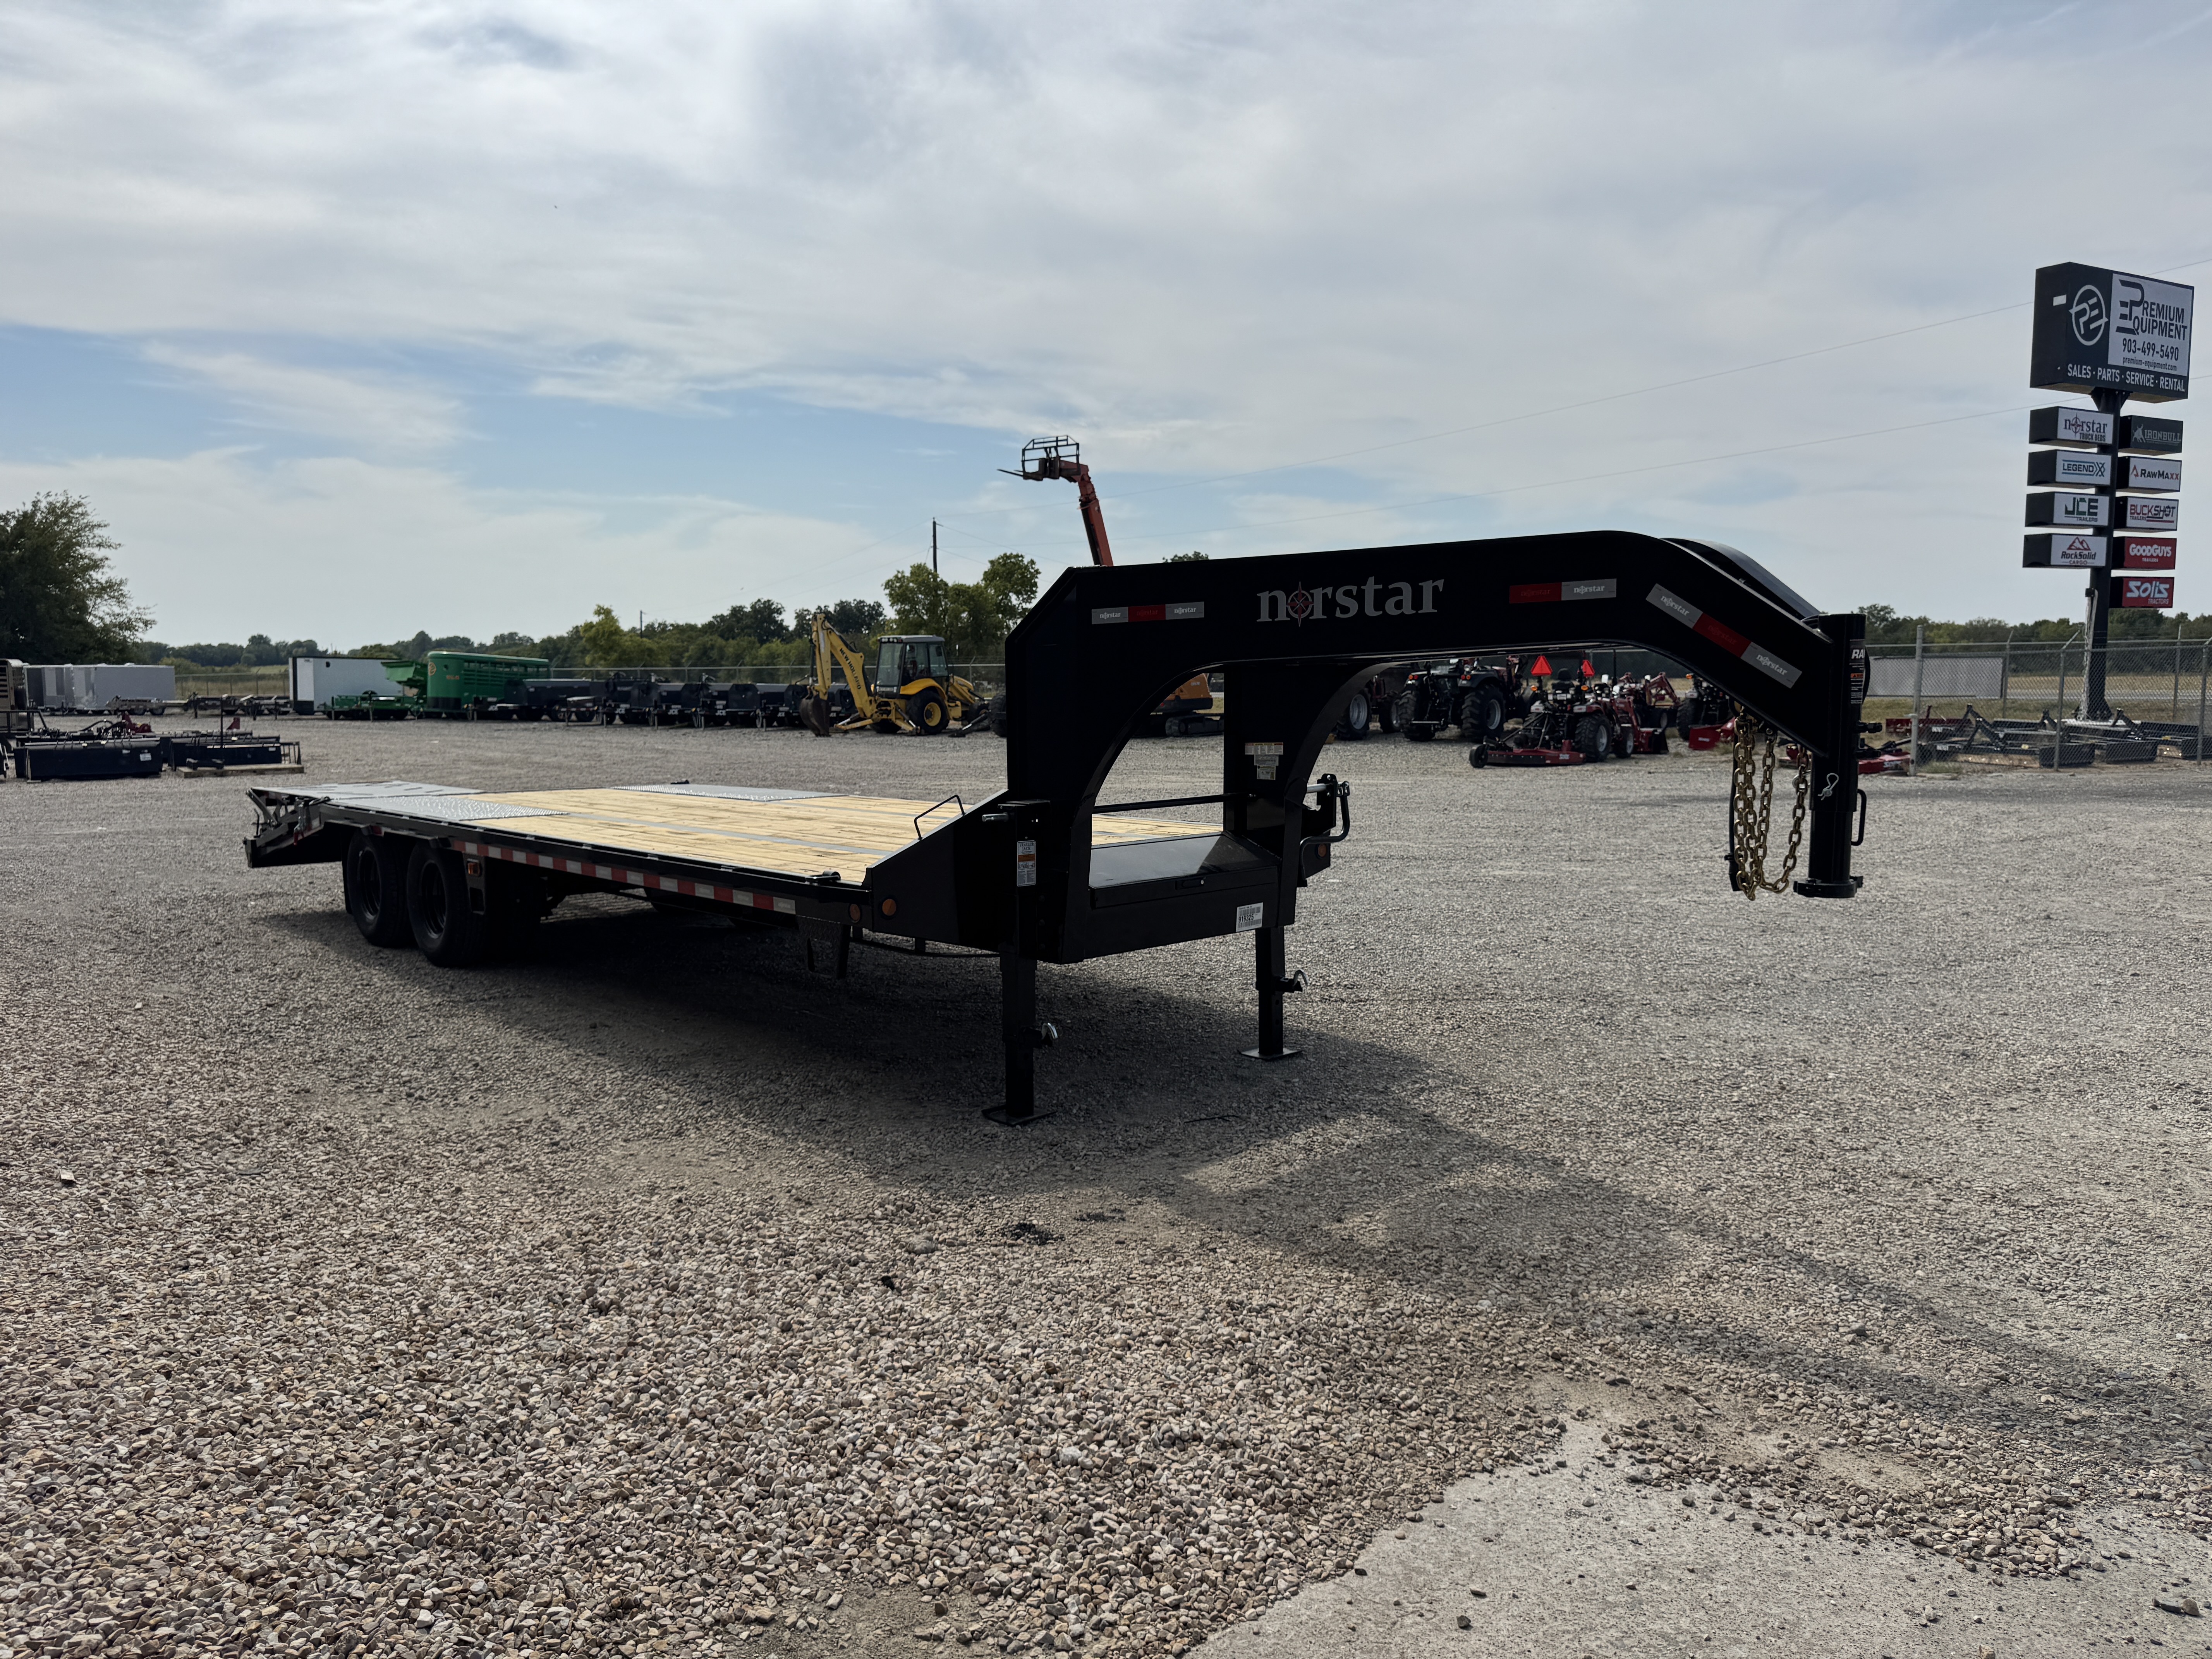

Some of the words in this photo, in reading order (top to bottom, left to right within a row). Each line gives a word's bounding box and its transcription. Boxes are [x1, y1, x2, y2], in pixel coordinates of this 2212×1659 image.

[2119, 279, 2184, 324] PREMIUM
[2116, 301, 2187, 340] EQUIPMENT
[2123, 338, 2179, 361] 903-499-5490
[2123, 357, 2177, 371] premium-equipment.com
[2068, 364, 2091, 378] SALES
[2097, 368, 2120, 382] PARTS
[2126, 371, 2154, 387] SERVICE
[2160, 376, 2185, 392] RENTAL
[2064, 414, 2107, 437] norstar
[2144, 429, 2181, 441] IRONBULL
[2095, 433, 2106, 441] BEDS
[2064, 497, 2098, 516] JCE
[2130, 504, 2176, 518] BUCKSHOT
[2061, 551, 2096, 560] RockSolid
[1574, 586, 1605, 594] norstar
[1257, 576, 1444, 627] norstar
[1661, 595, 1690, 616] norstar
[1756, 654, 1788, 675] norstar
[1851, 649, 1865, 659] RA
[848, 661, 861, 689] HOLAND
[1238, 914, 1254, 923] 919325
